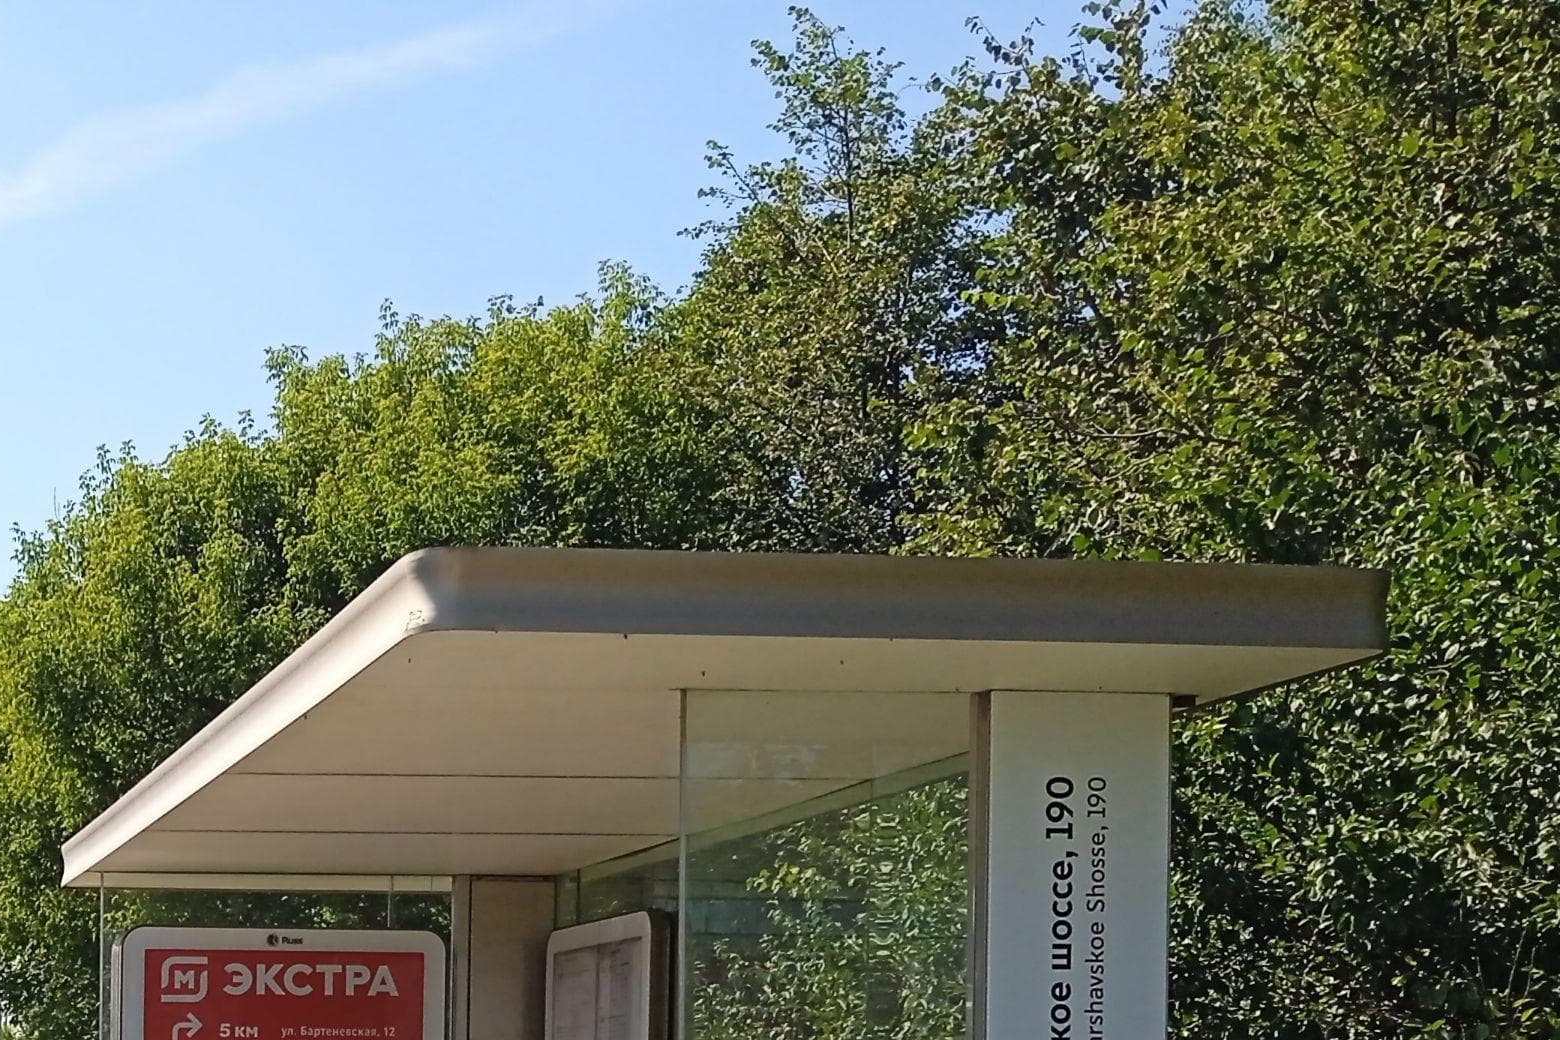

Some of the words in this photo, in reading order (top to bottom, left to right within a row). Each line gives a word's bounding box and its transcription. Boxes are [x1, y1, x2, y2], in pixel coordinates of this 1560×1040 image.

[1045, 776, 1075, 841] 190
[1086, 776, 1107, 819] 190
[1084, 826, 1109, 913] Shosse,
[1048, 850, 1079, 972] шоссе,
[223, 962, 400, 997] ЭКСТРА
[219, 1023, 231, 1038] 5
[281, 1027, 297, 1039] ул.
[384, 1027, 396, 1037] 12
